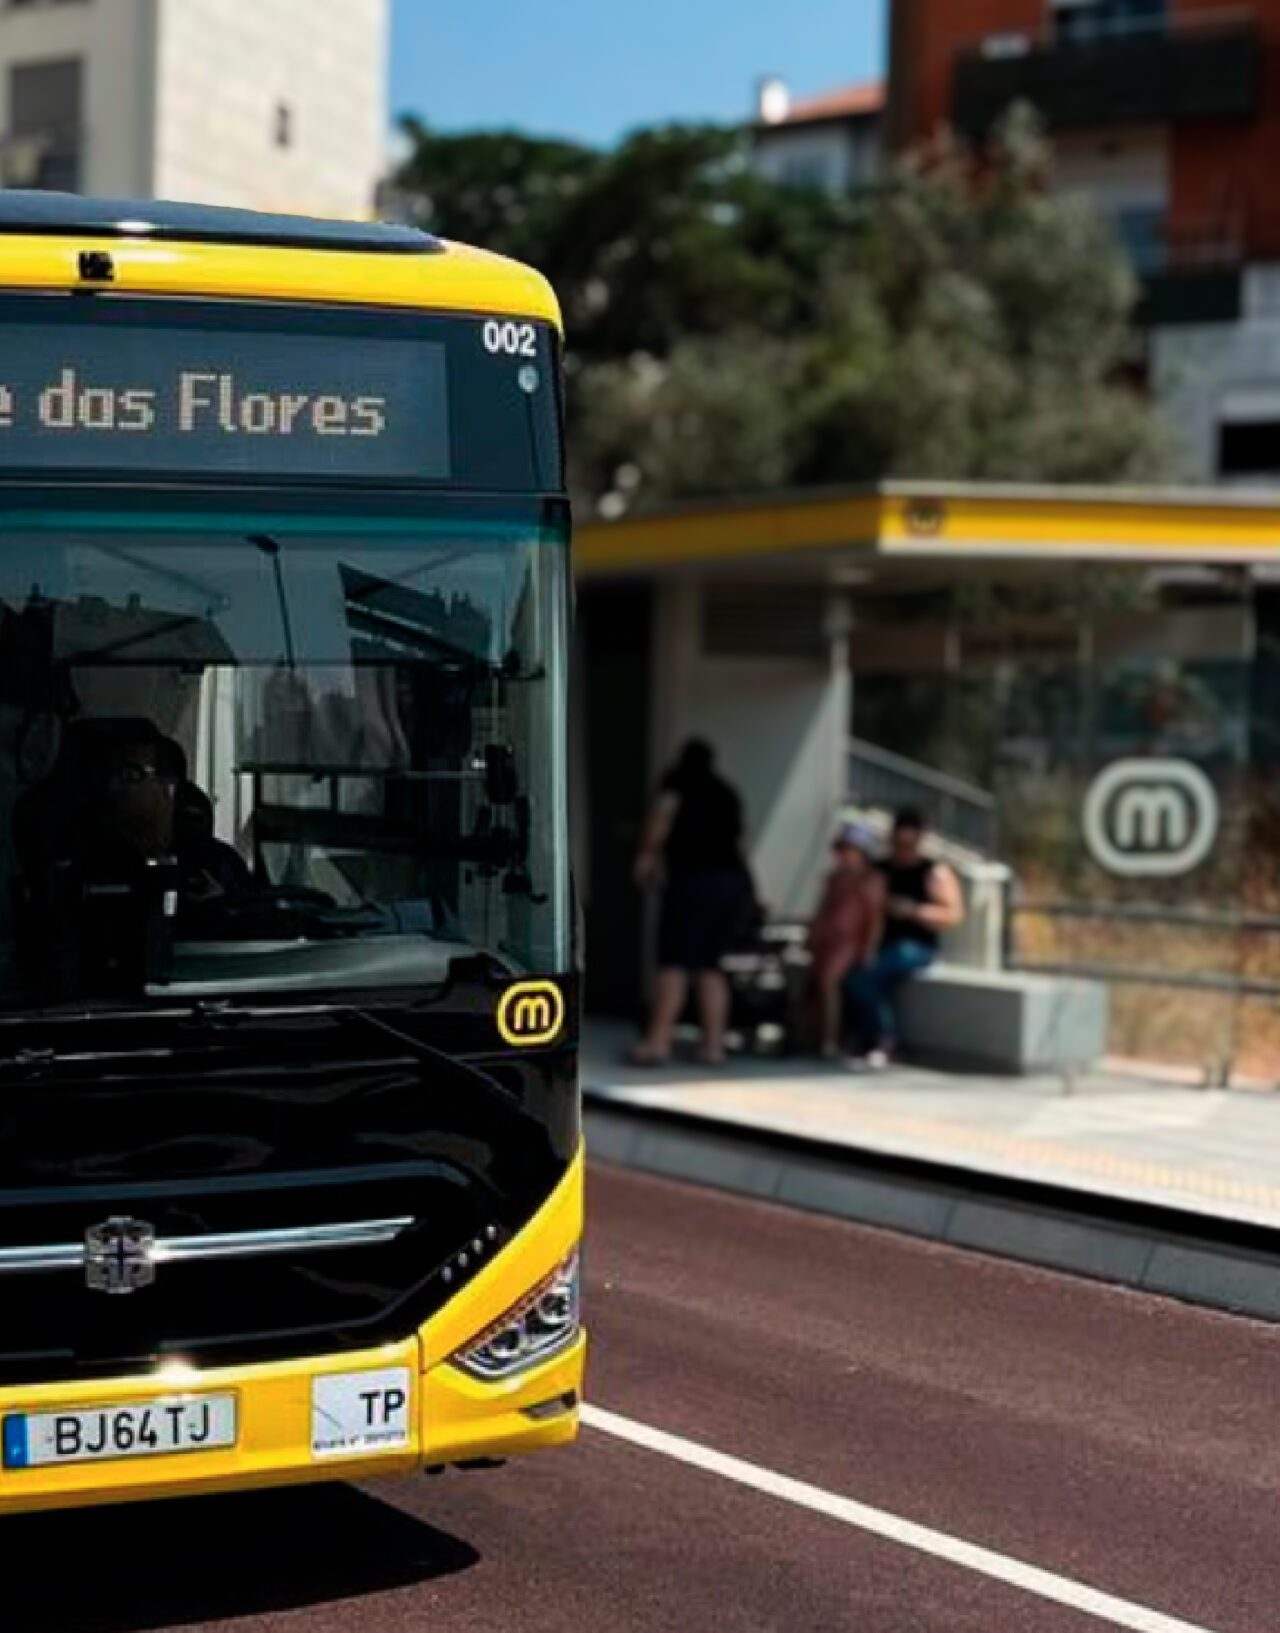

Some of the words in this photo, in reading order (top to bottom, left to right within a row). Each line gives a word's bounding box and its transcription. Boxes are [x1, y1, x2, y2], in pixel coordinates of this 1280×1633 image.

[483, 321, 537, 356] 002
[39, 368, 156, 430] das
[178, 371, 386, 436] Flores
[358, 1389, 406, 1427] TP
